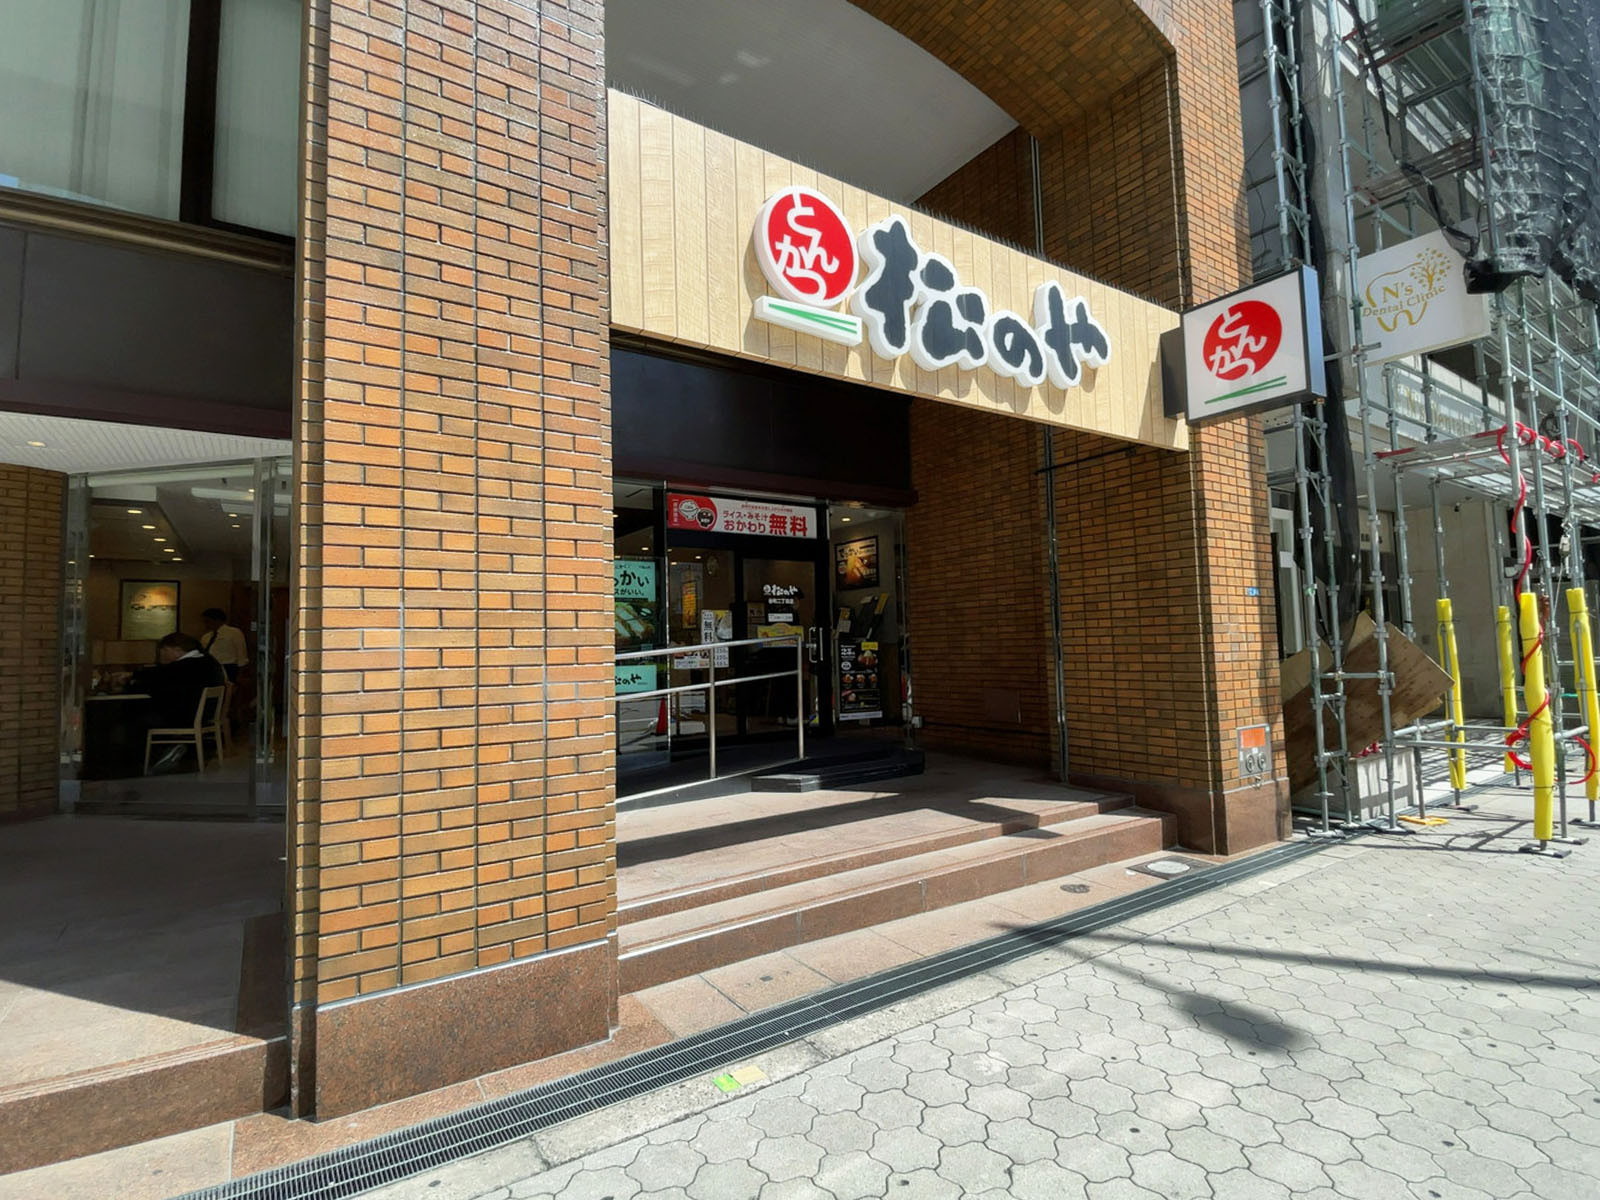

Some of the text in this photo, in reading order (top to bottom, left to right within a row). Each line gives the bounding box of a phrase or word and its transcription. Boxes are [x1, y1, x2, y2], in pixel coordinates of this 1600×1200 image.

[773, 189, 841, 301] とんかつ
[864, 219, 1109, 381] 松のや
[1362, 285, 1446, 317] Dental Clinic
[1382, 281, 1414, 303] N's
[1208, 305, 1268, 378] とんかつ
[723, 513, 808, 537] おかわり 無料
